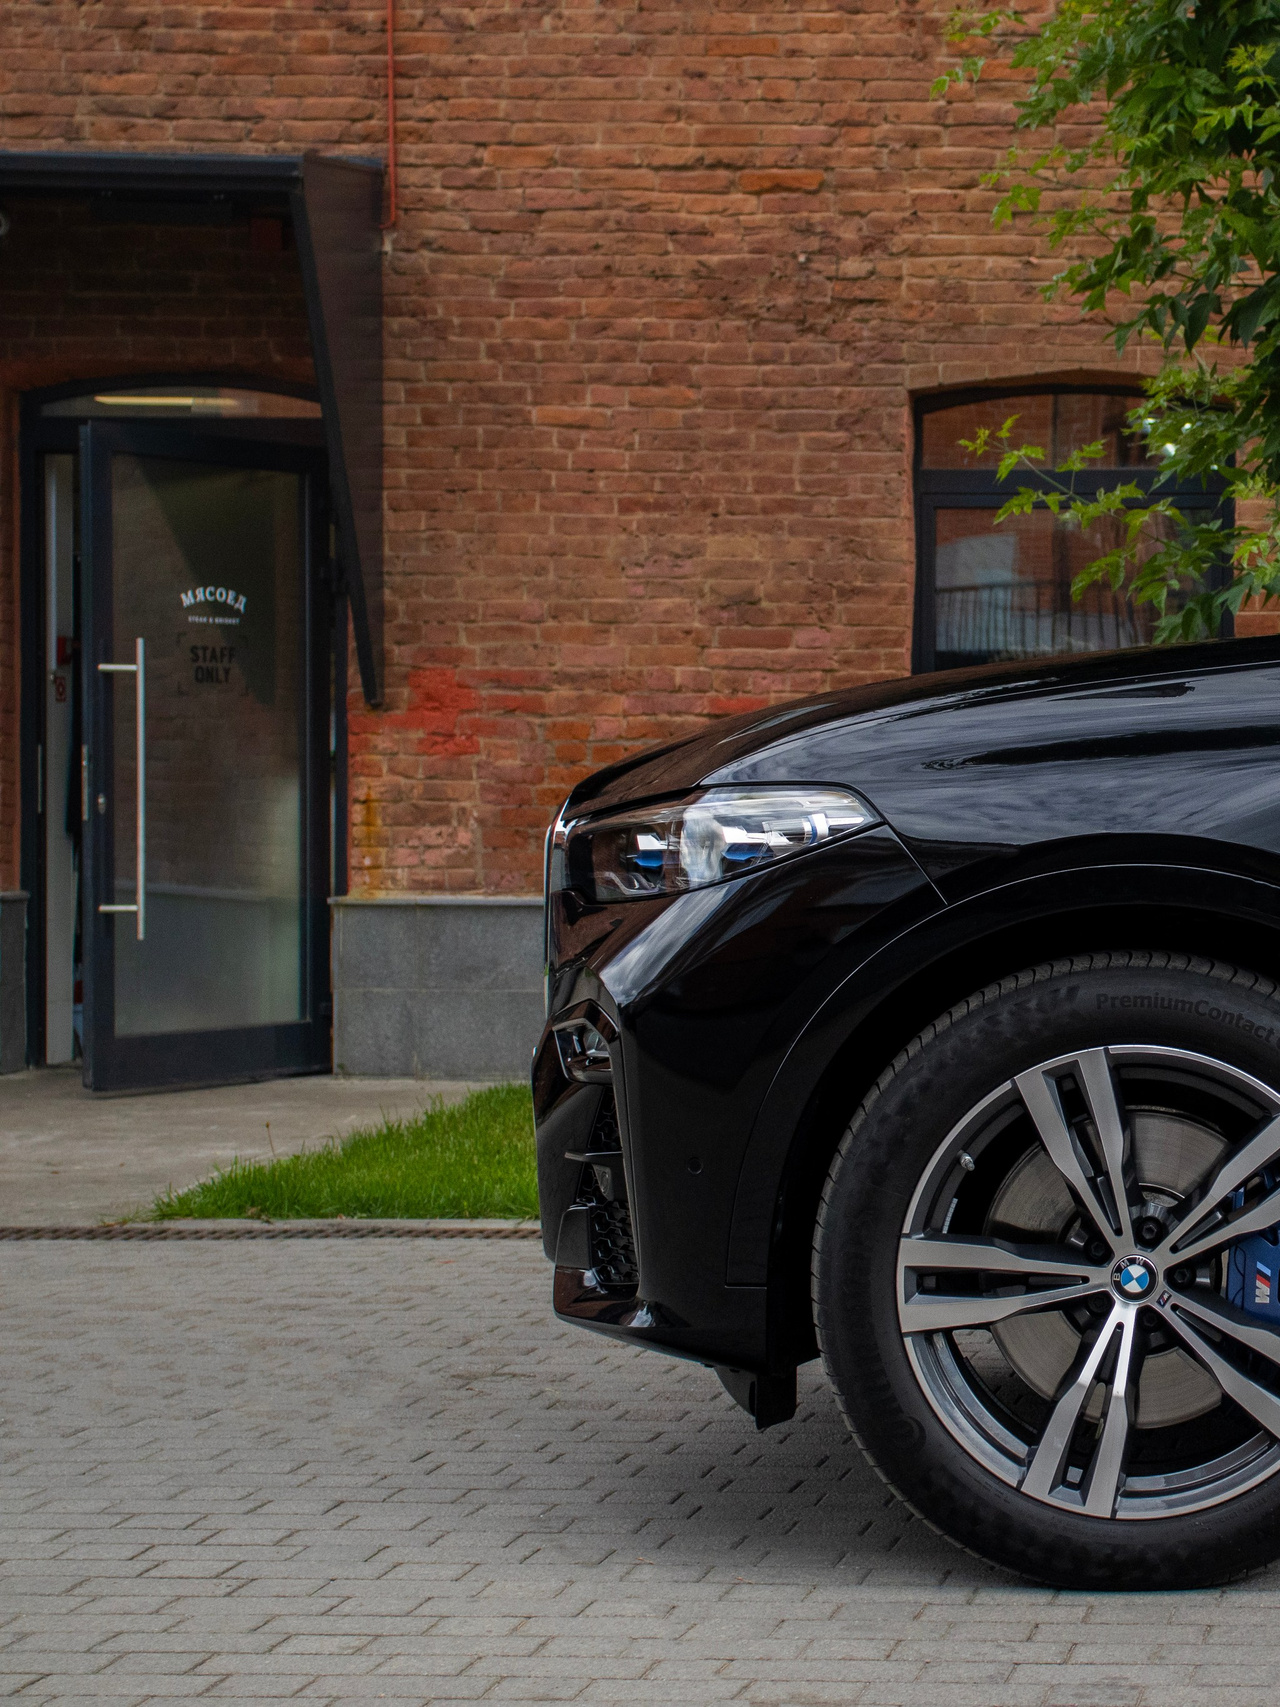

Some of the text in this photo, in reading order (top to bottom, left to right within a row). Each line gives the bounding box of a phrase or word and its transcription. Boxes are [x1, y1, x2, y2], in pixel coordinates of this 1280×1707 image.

[180, 586, 247, 613] МЯСОЕД
[190, 645, 236, 663] STAFF
[194, 665, 231, 683] ONLY
[1096, 992, 1276, 1044] PremiumContact
[1113, 1256, 1145, 1281] BMW
